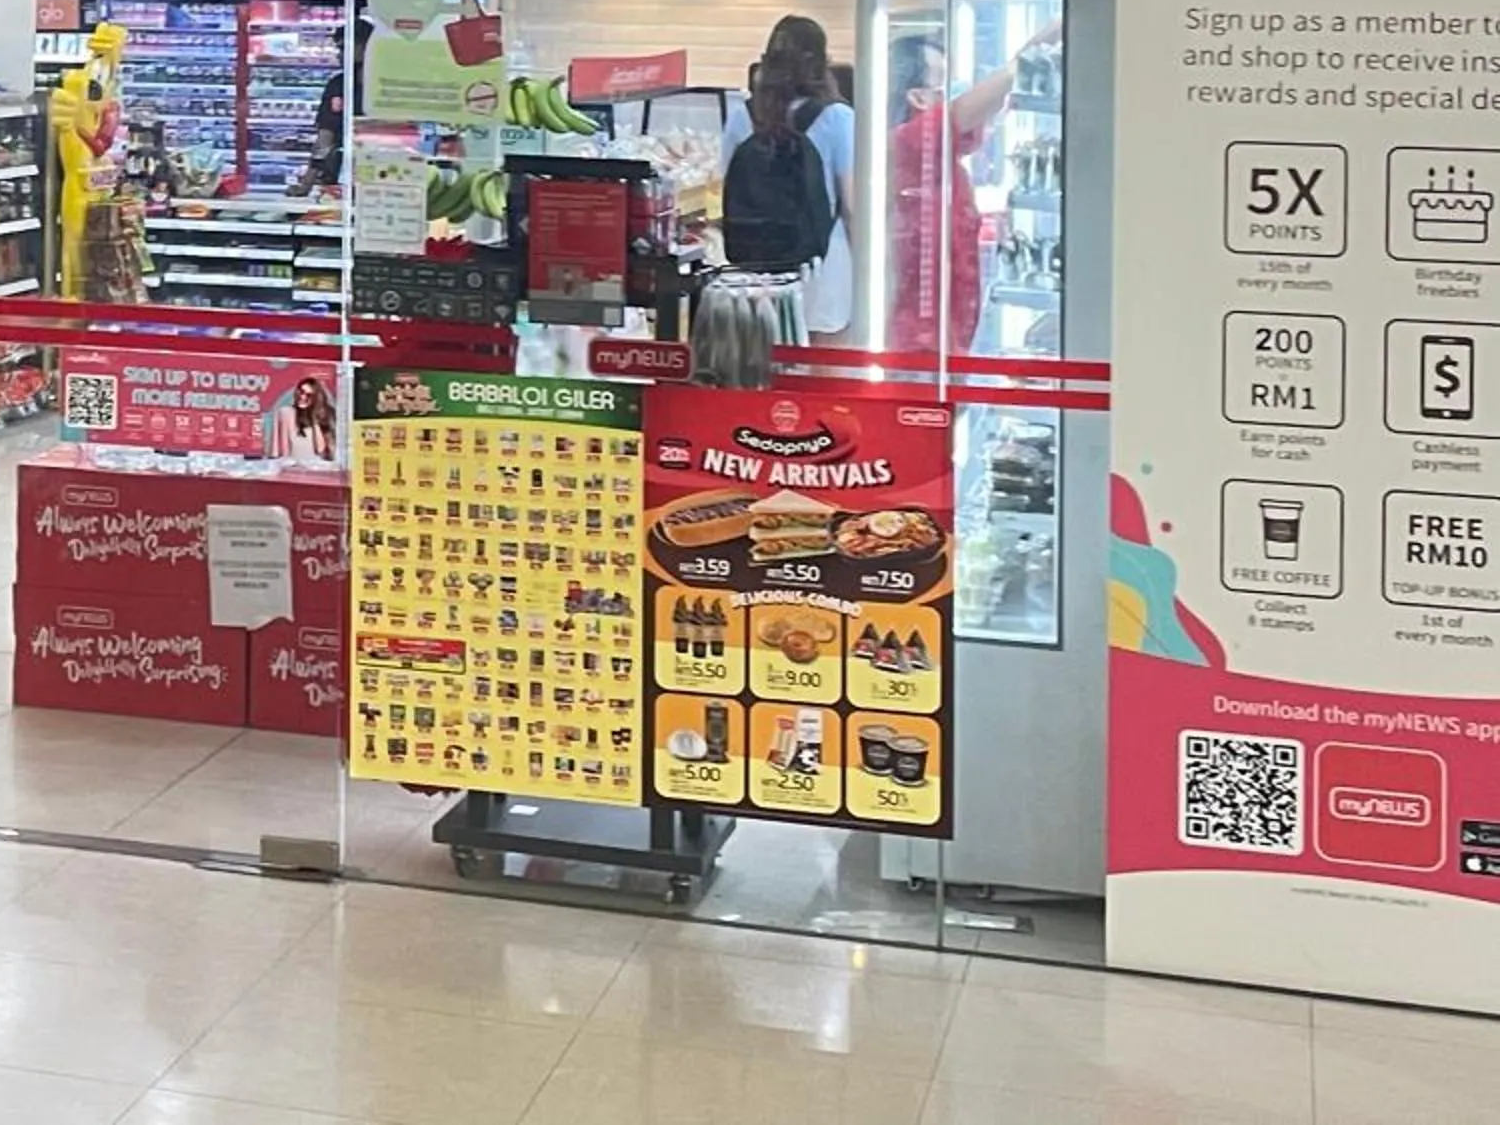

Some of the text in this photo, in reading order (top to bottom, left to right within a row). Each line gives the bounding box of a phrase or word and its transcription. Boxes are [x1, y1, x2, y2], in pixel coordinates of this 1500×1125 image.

[1185, 7, 1243, 36] Sign
[1250, 13, 1285, 36] up
[1292, 15, 1323, 32] as
[1331, 16, 1347, 32] a
[1355, 12, 1477, 35] member
[1182, 45, 1233, 67] and
[1240, 45, 1308, 73] shop
[1317, 48, 1345, 69] to
[1353, 48, 1454, 72] receive
[1187, 81, 1297, 105] rewards
[1304, 84, 1357, 107] and
[1365, 85, 1463, 113] special
[1246, 167, 1324, 216] 5X
[1249, 223, 1323, 242] POINTS
[1258, 260, 1313, 275] 15th of
[1414, 267, 1483, 286] Birthday
[1236, 276, 1334, 292] every month
[1416, 282, 1480, 299] freebies
[1254, 327, 1314, 355] 200
[596, 348, 686, 369] myNEWS
[1254, 355, 1314, 371] POINTS
[190, 371, 215, 388] TO
[448, 381, 549, 406] BERBALOI
[554, 388, 615, 411] GILER
[1250, 383, 1316, 410] RM1
[1239, 429, 1326, 448] Earn points
[1412, 440, 1480, 458] Cashless
[1251, 445, 1311, 461] for cash
[703, 449, 892, 487] NEW ARRIVALS
[1411, 457, 1481, 474] payment
[1408, 513, 1484, 541] FREE
[1406, 542, 1488, 569] RM10
[1232, 566, 1332, 587] FREE COFFEE
[1392, 580, 1500, 602] TOP-UP BONUS
[1254, 598, 1308, 615] Collect
[1260, 616, 1316, 633] stamps
[1421, 613, 1464, 629] 1st of
[1394, 627, 1494, 648] every month
[1213, 695, 1319, 722] Download
[1323, 705, 1360, 726] the
[1363, 712, 1461, 736] myNEWS
